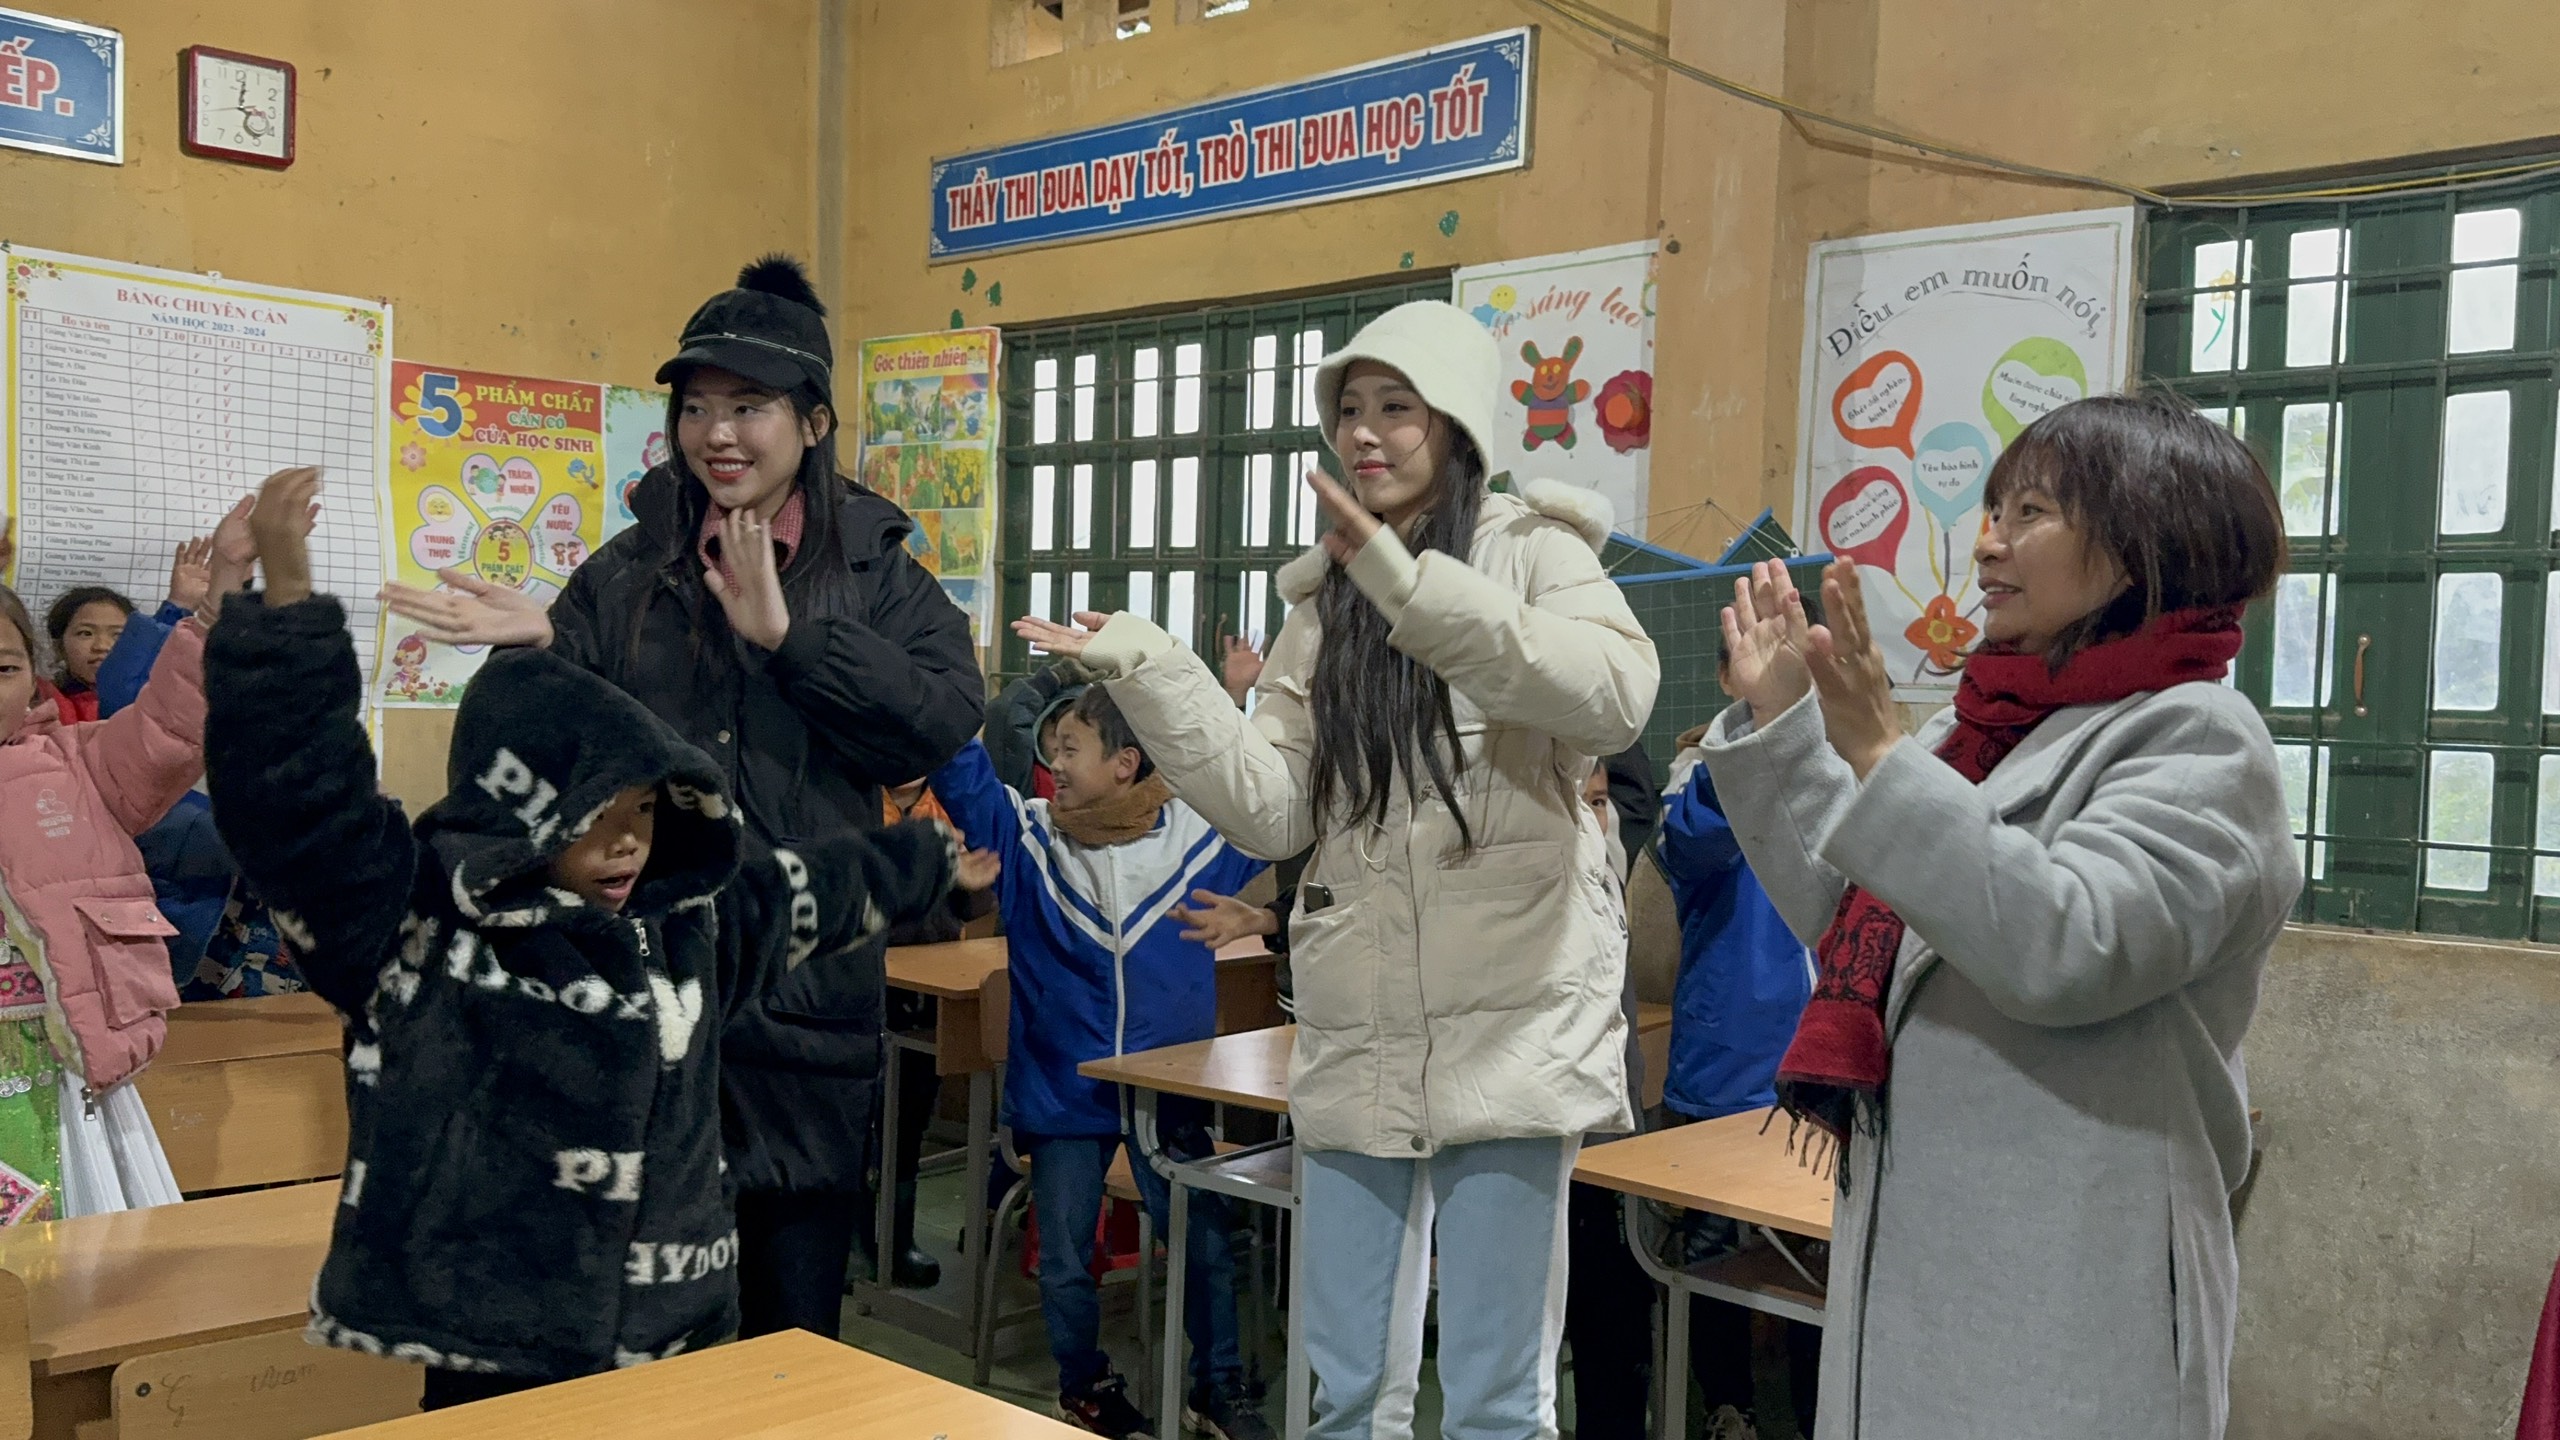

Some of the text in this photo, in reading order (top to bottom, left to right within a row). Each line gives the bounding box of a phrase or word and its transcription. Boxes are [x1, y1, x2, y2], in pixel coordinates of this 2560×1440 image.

[268, 88, 277, 101] 2
[268, 107, 276, 120] 3
[947, 63, 1489, 232] THẦY THI ĐUA DẠY TỐT, TRÒ THI ĐUA HỌC TỐT
[117, 287, 168, 308] BẢNG
[172, 297, 246, 319] CHUYÊN
[1526, 284, 1642, 329] sáng tạo
[1826, 293, 1895, 358] Điều
[1904, 270, 1949, 301] em
[1962, 252, 2049, 293] muốn
[137, 326, 153, 337] T.9
[152, 313, 179, 325] NĂM
[182, 316, 210, 329] HỌC
[211, 321, 234, 333] 2023
[243, 326, 266, 337] 2024
[164, 330, 185, 340] T.10
[898, 349, 930, 371] thiên
[933, 345, 967, 368] nhiên
[418, 373, 463, 437] 5
[475, 380, 594, 413] PHẨM CHẤT
[507, 406, 567, 430] CẦN CÓ
[474, 423, 594, 453] CỦA HỌC SINH
[551, 503, 570, 515] YÊU
[546, 519, 573, 531] NƯỚC
[424, 535, 455, 545] TRUNG
[498, 541, 511, 562] 5
[428, 548, 451, 559] THỰC
